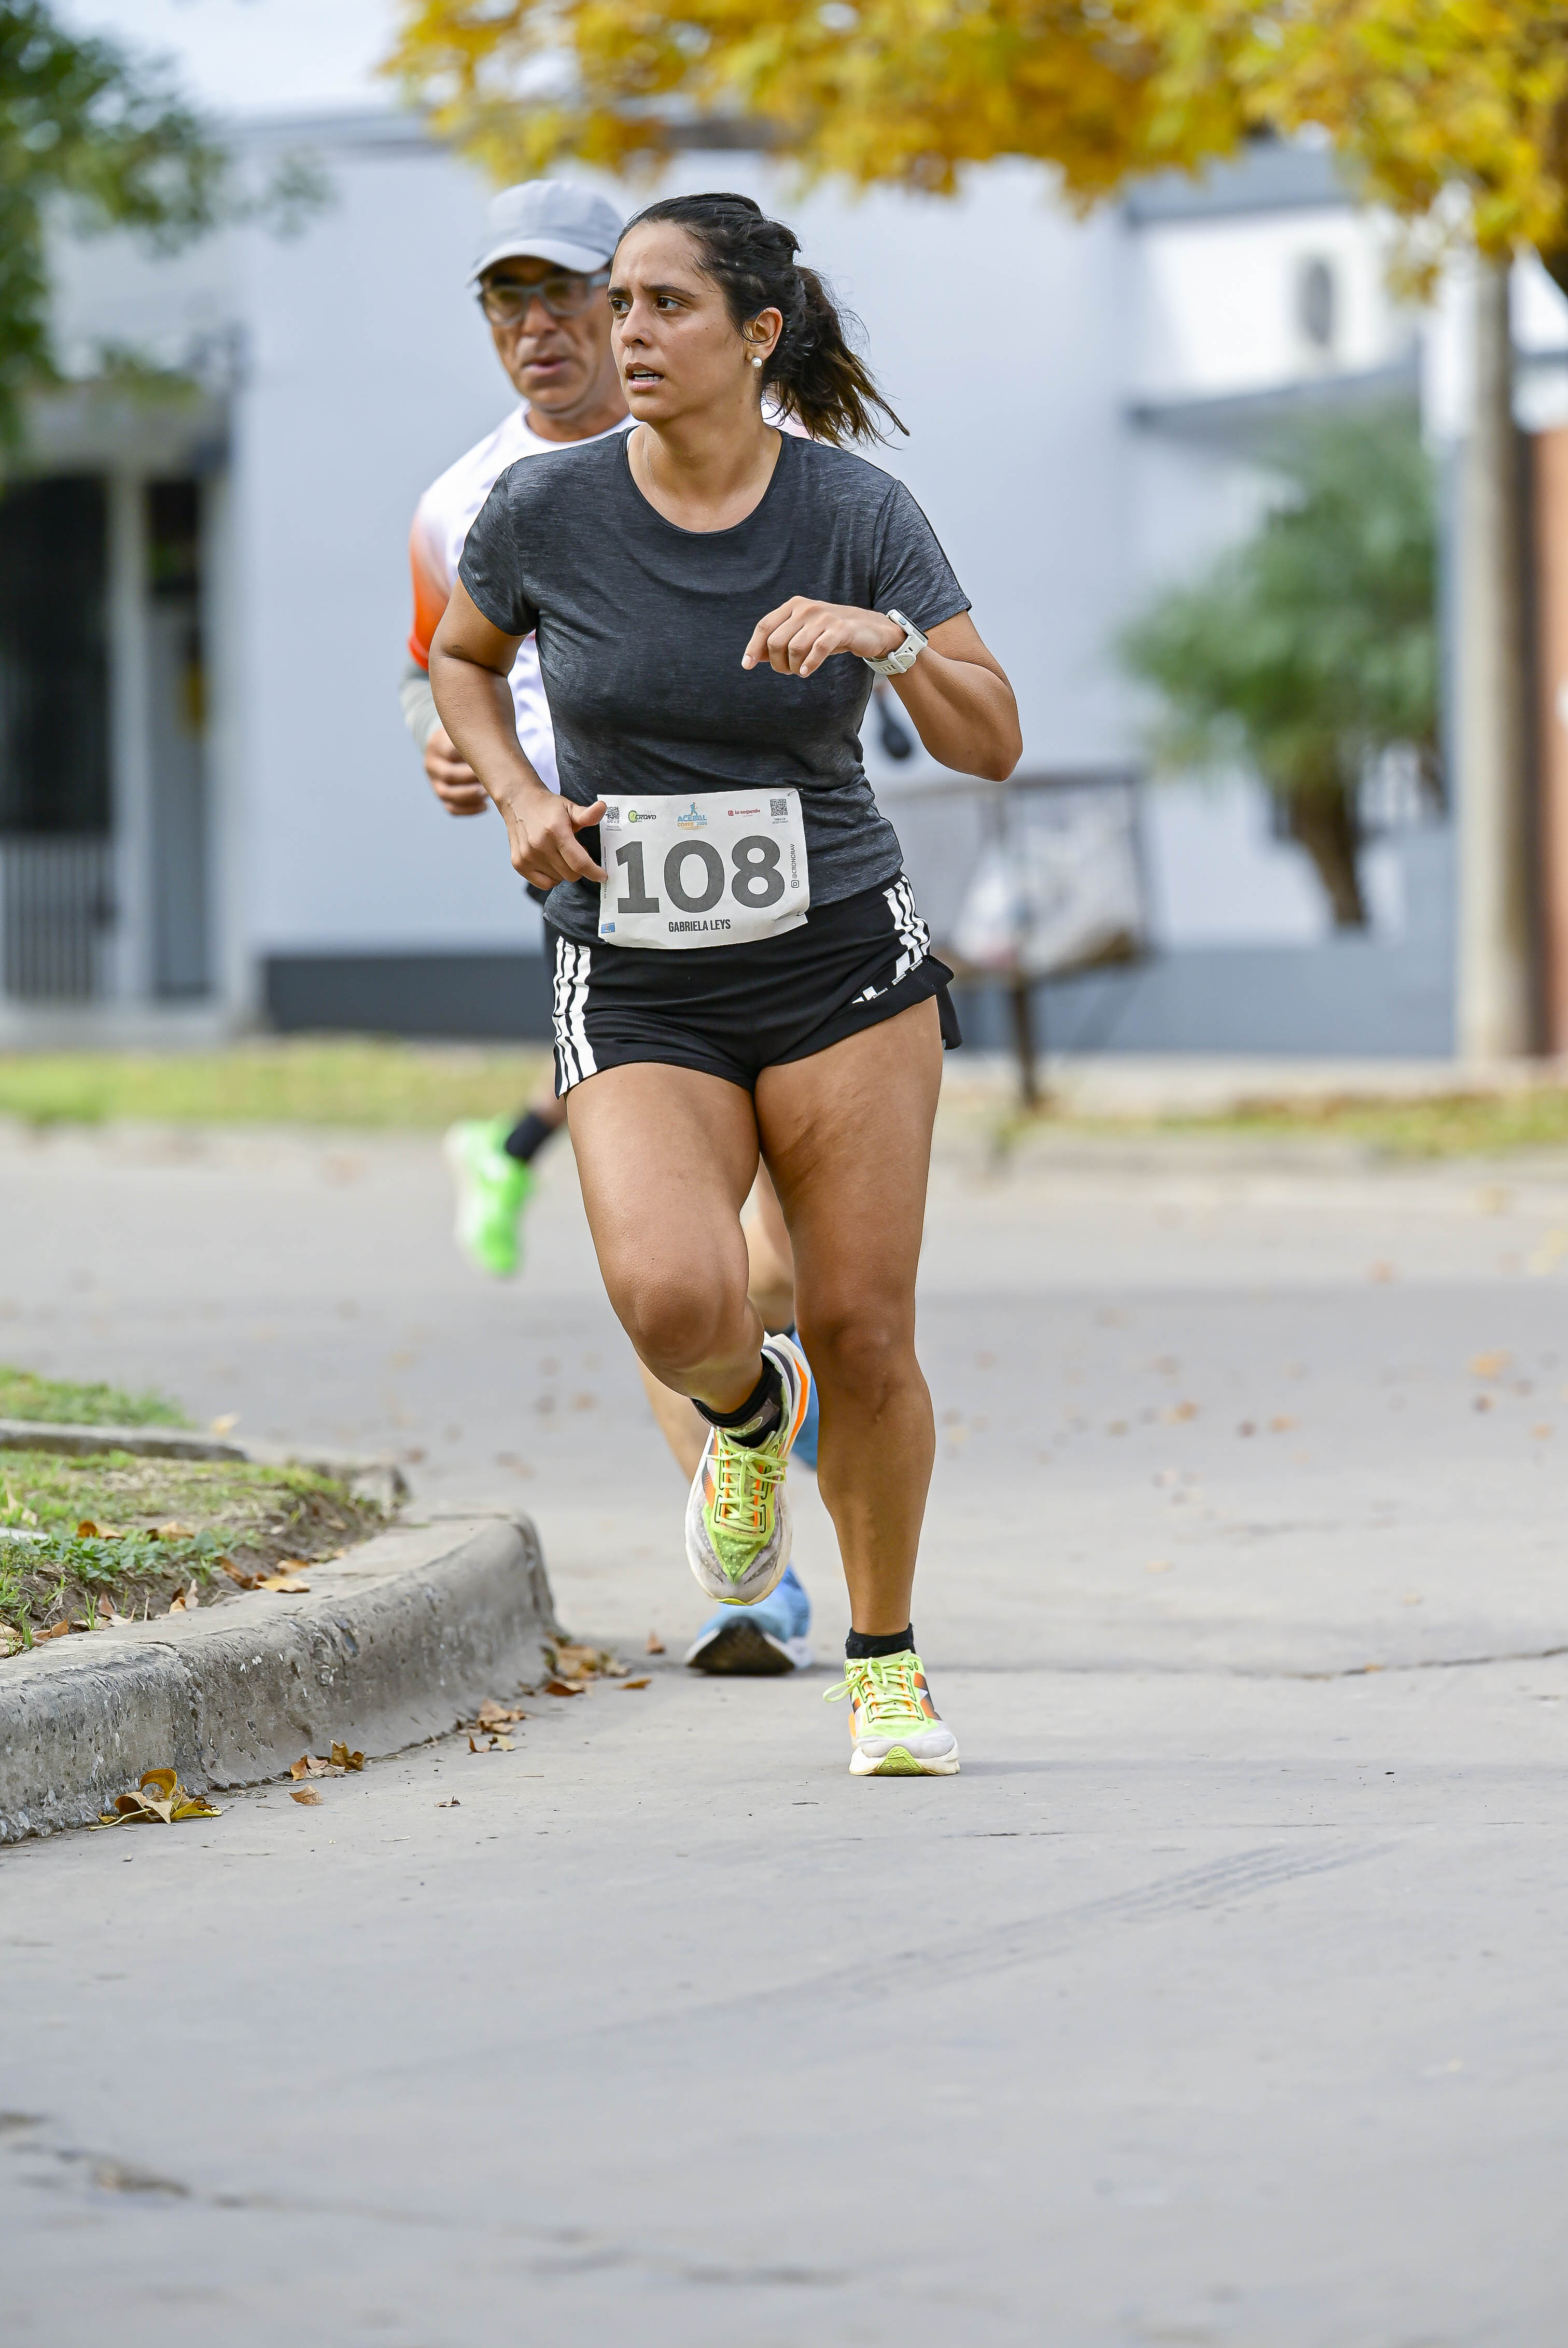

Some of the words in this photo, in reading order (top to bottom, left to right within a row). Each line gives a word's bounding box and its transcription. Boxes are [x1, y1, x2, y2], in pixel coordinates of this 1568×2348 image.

[615, 835, 785, 914] 108
[668, 920, 709, 932] GABRIELA
[710, 919, 731, 930] LEYS
